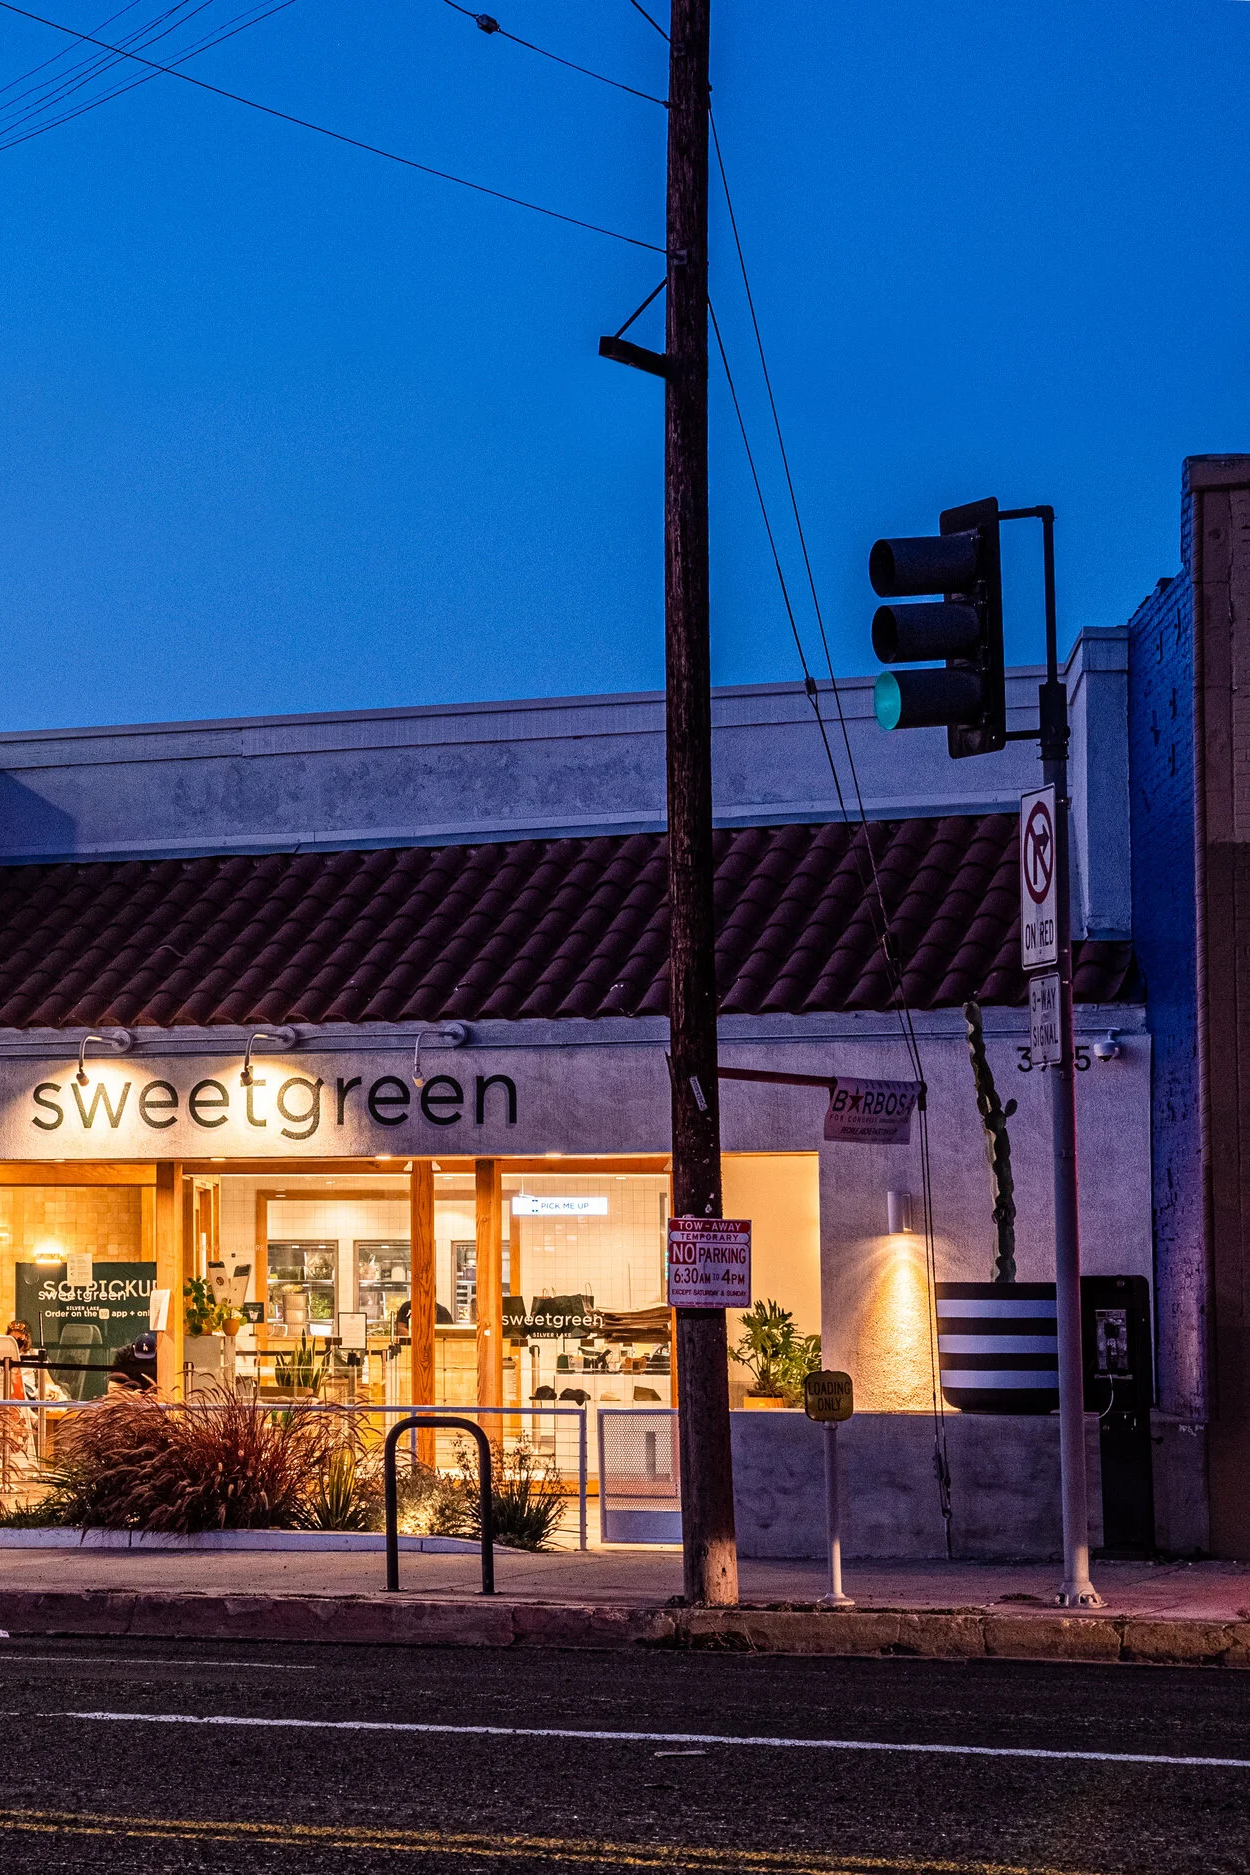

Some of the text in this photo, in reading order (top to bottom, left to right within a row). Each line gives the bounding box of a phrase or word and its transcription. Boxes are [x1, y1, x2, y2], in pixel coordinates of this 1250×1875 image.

[1025, 918, 1054, 950] ON RED
[1032, 987, 1056, 1012] 3-WAY
[1033, 1022, 1058, 1048] SIGNAL
[31, 1066, 518, 1140] sweetgreen
[680, 1233, 739, 1241] TEMPORARY
[672, 1243, 746, 1264] NO PARKING
[38, 1289, 127, 1302] sweetgreen
[45, 1310, 69, 1318] Order
[84, 1309, 97, 1318] the
[111, 1311, 128, 1319] app
[502, 1313, 604, 1328] sweetgreen
[808, 1381, 851, 1395] LOADING
[817, 1397, 842, 1411] ONLY
